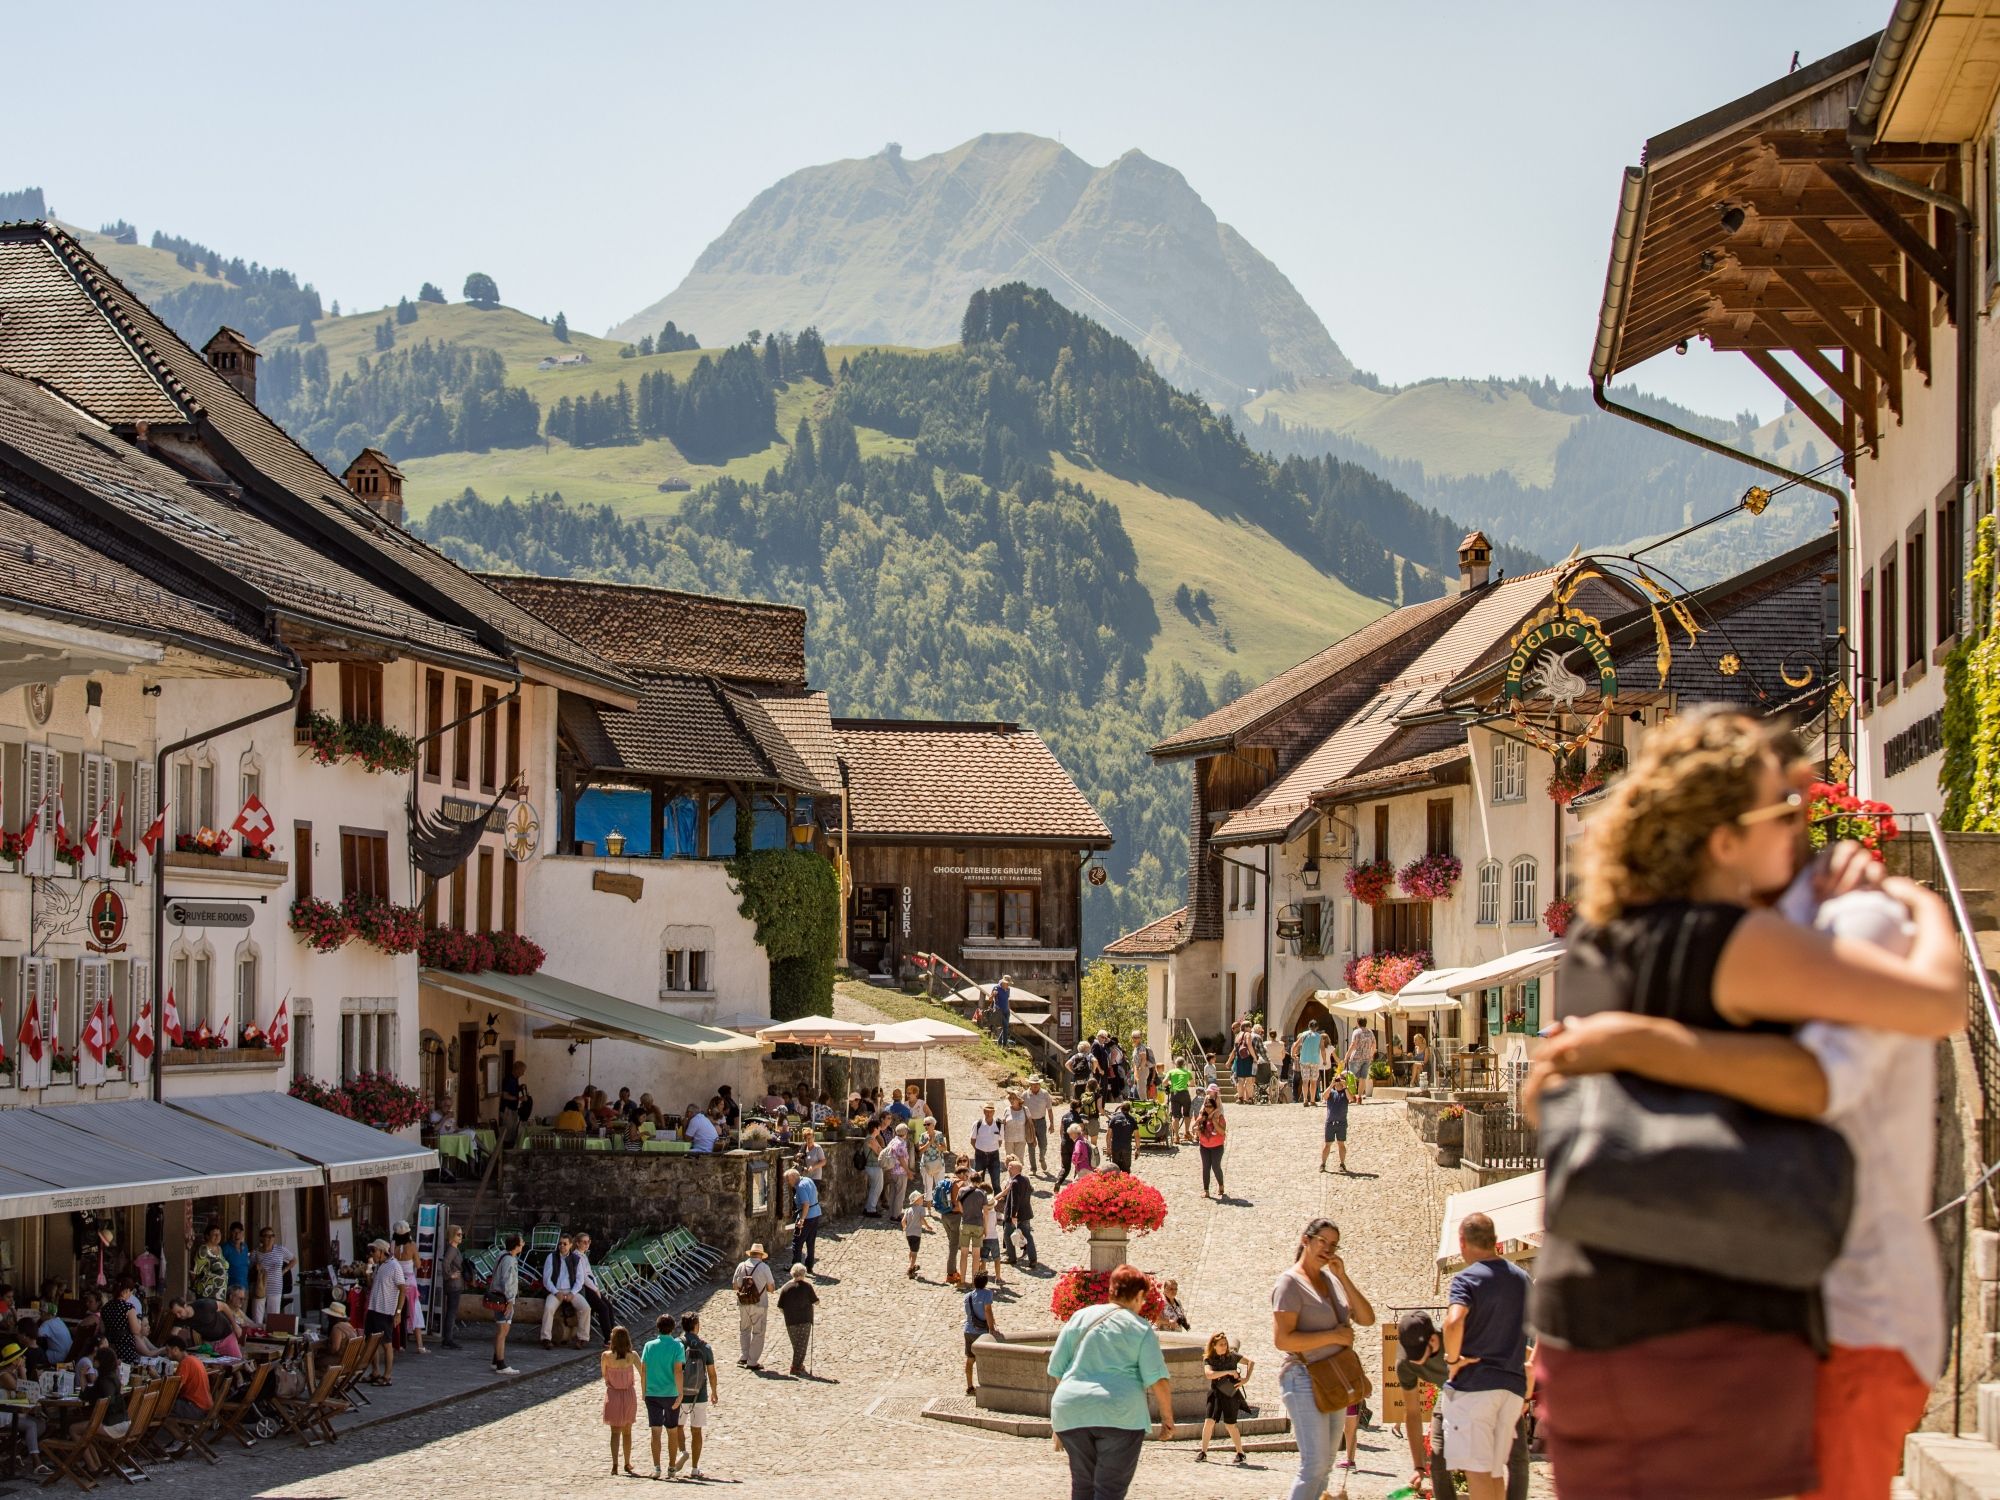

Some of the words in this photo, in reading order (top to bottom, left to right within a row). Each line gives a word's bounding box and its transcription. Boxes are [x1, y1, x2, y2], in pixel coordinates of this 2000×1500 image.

[1506, 629, 1549, 682] HOTEL
[1551, 622, 1580, 638] DE
[1583, 631, 1617, 680] VILLE
[933, 866, 991, 874] CHOCOLATERIE
[1003, 866, 1042, 875] GRUYÈRES
[217, 912, 248, 922] ROOMS
[902, 886, 912, 938] OUVERT
